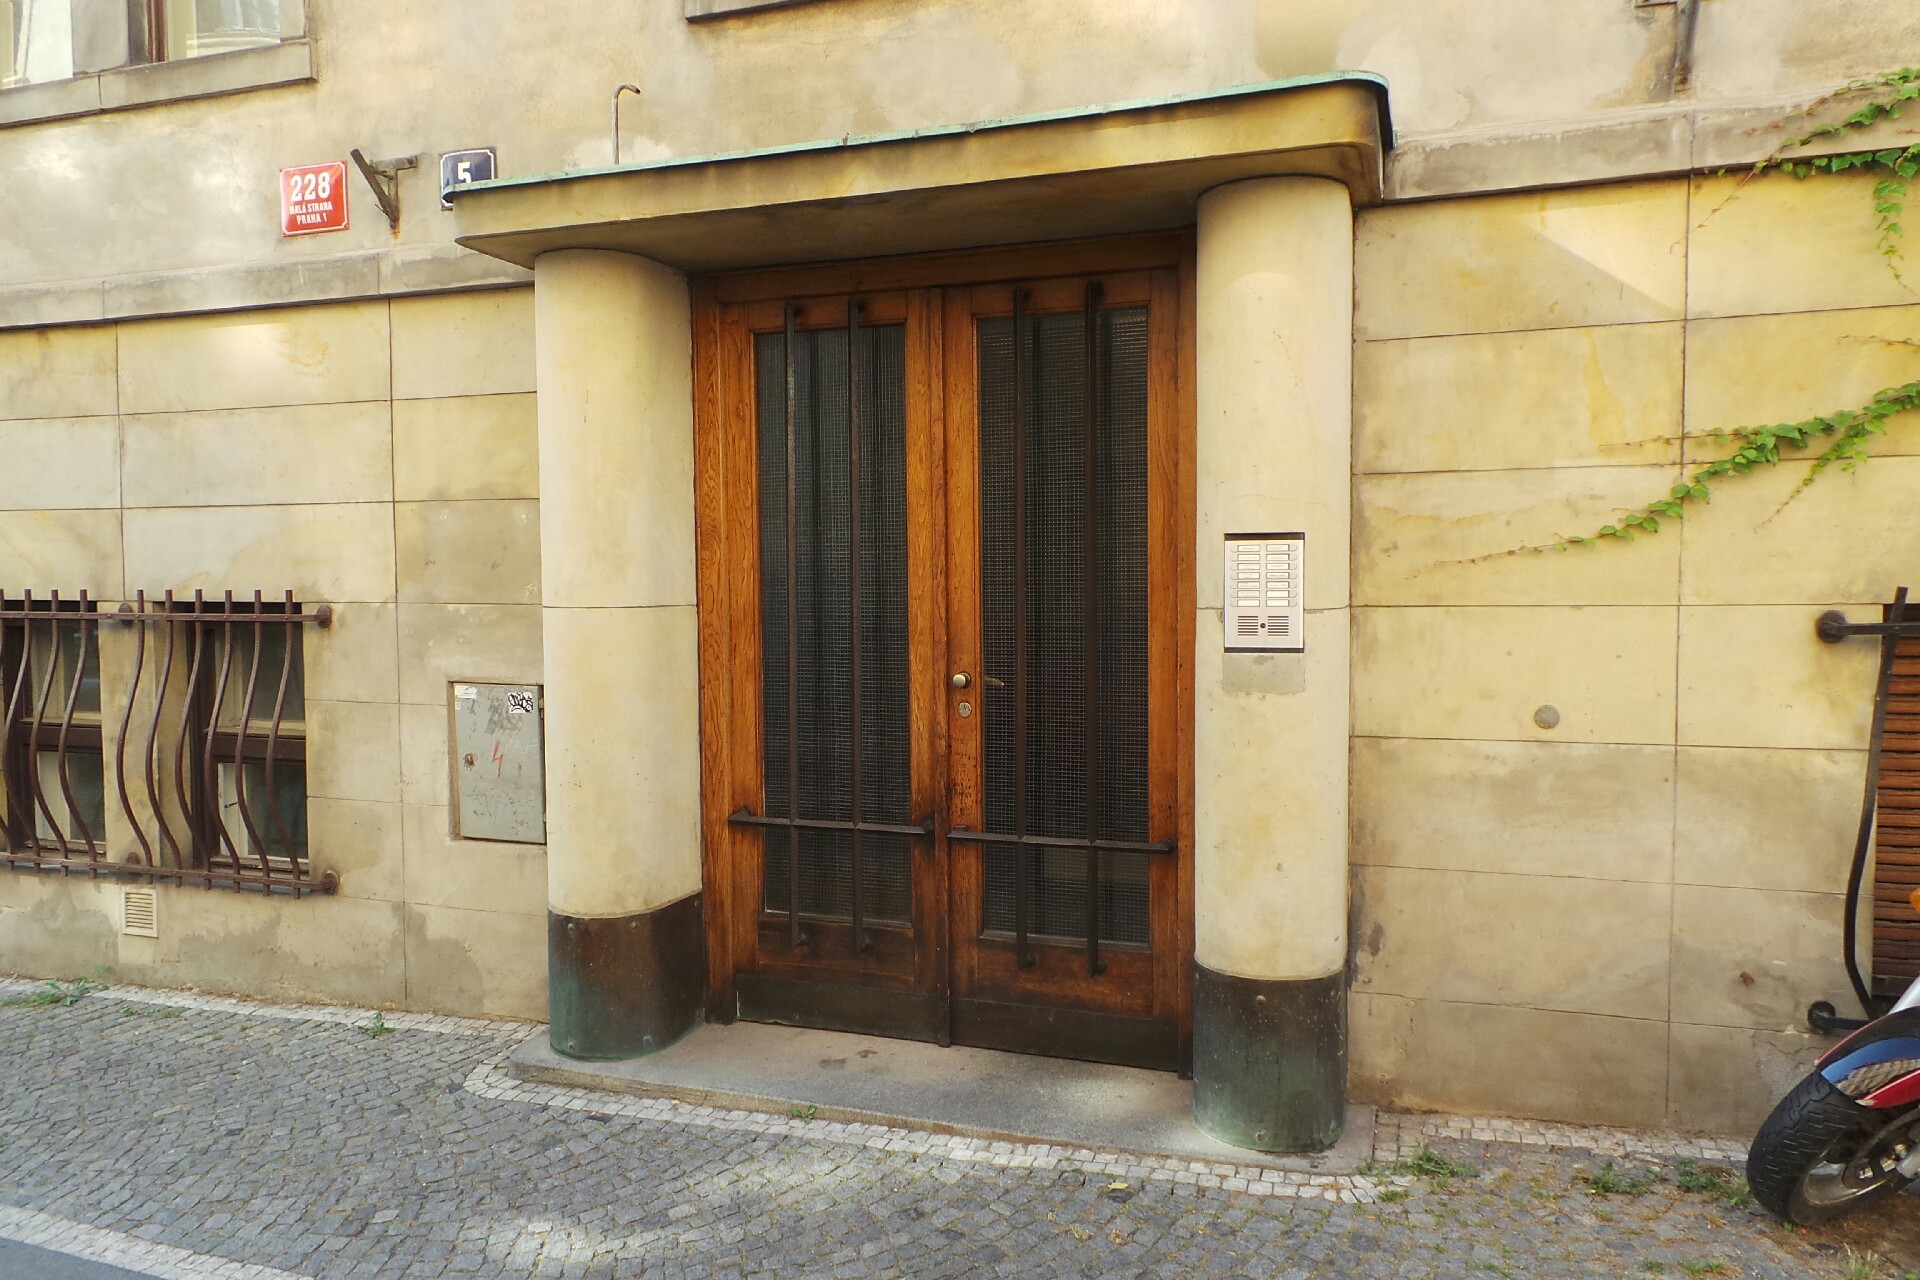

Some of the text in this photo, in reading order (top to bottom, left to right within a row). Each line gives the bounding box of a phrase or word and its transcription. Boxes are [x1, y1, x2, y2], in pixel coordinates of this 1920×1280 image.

[457, 161, 472, 183] 5
[290, 171, 331, 201] 228
[289, 201, 333, 215] MALÁ STRANA
[296, 212, 327, 224] PRAHA 1
